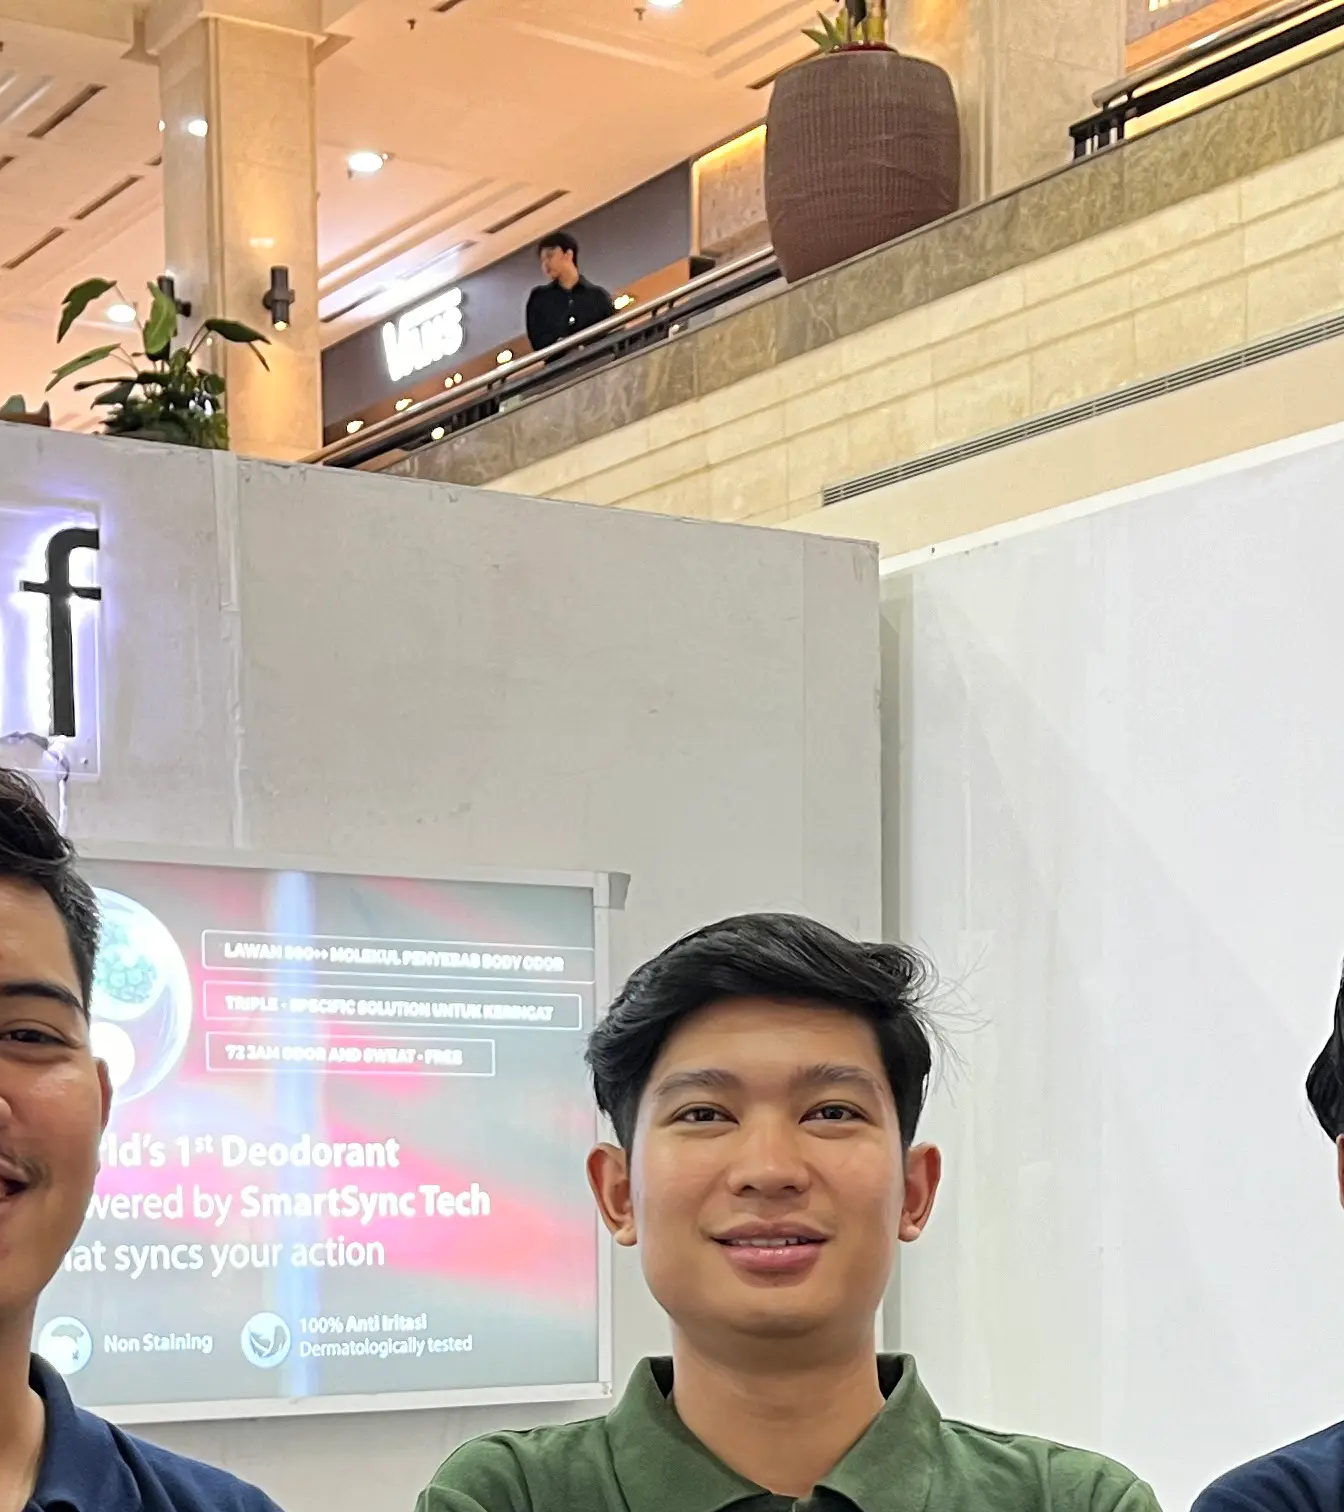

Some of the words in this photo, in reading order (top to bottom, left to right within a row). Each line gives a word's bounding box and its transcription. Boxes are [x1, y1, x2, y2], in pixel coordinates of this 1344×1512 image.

[225, 995, 277, 1012] TRIPLE
[357, 1000, 430, 1018] SOLUTION
[432, 1003, 482, 1020] UNTUK
[328, 1046, 361, 1063] AND
[174, 1134, 214, 1168] 1st
[221, 1133, 400, 1169] Deodorant
[193, 1184, 232, 1227] by
[241, 1184, 415, 1228] SmartSync
[420, 1184, 491, 1218] Tech
[115, 1244, 204, 1280] syncs
[211, 1243, 283, 1278] your
[290, 1235, 385, 1269] action
[300, 1316, 343, 1334] 100%
[346, 1314, 381, 1333] Anti
[104, 1334, 139, 1353] Non
[143, 1330, 212, 1354] Staining
[300, 1337, 425, 1359] Dermatologically
[428, 1335, 473, 1353] tested
